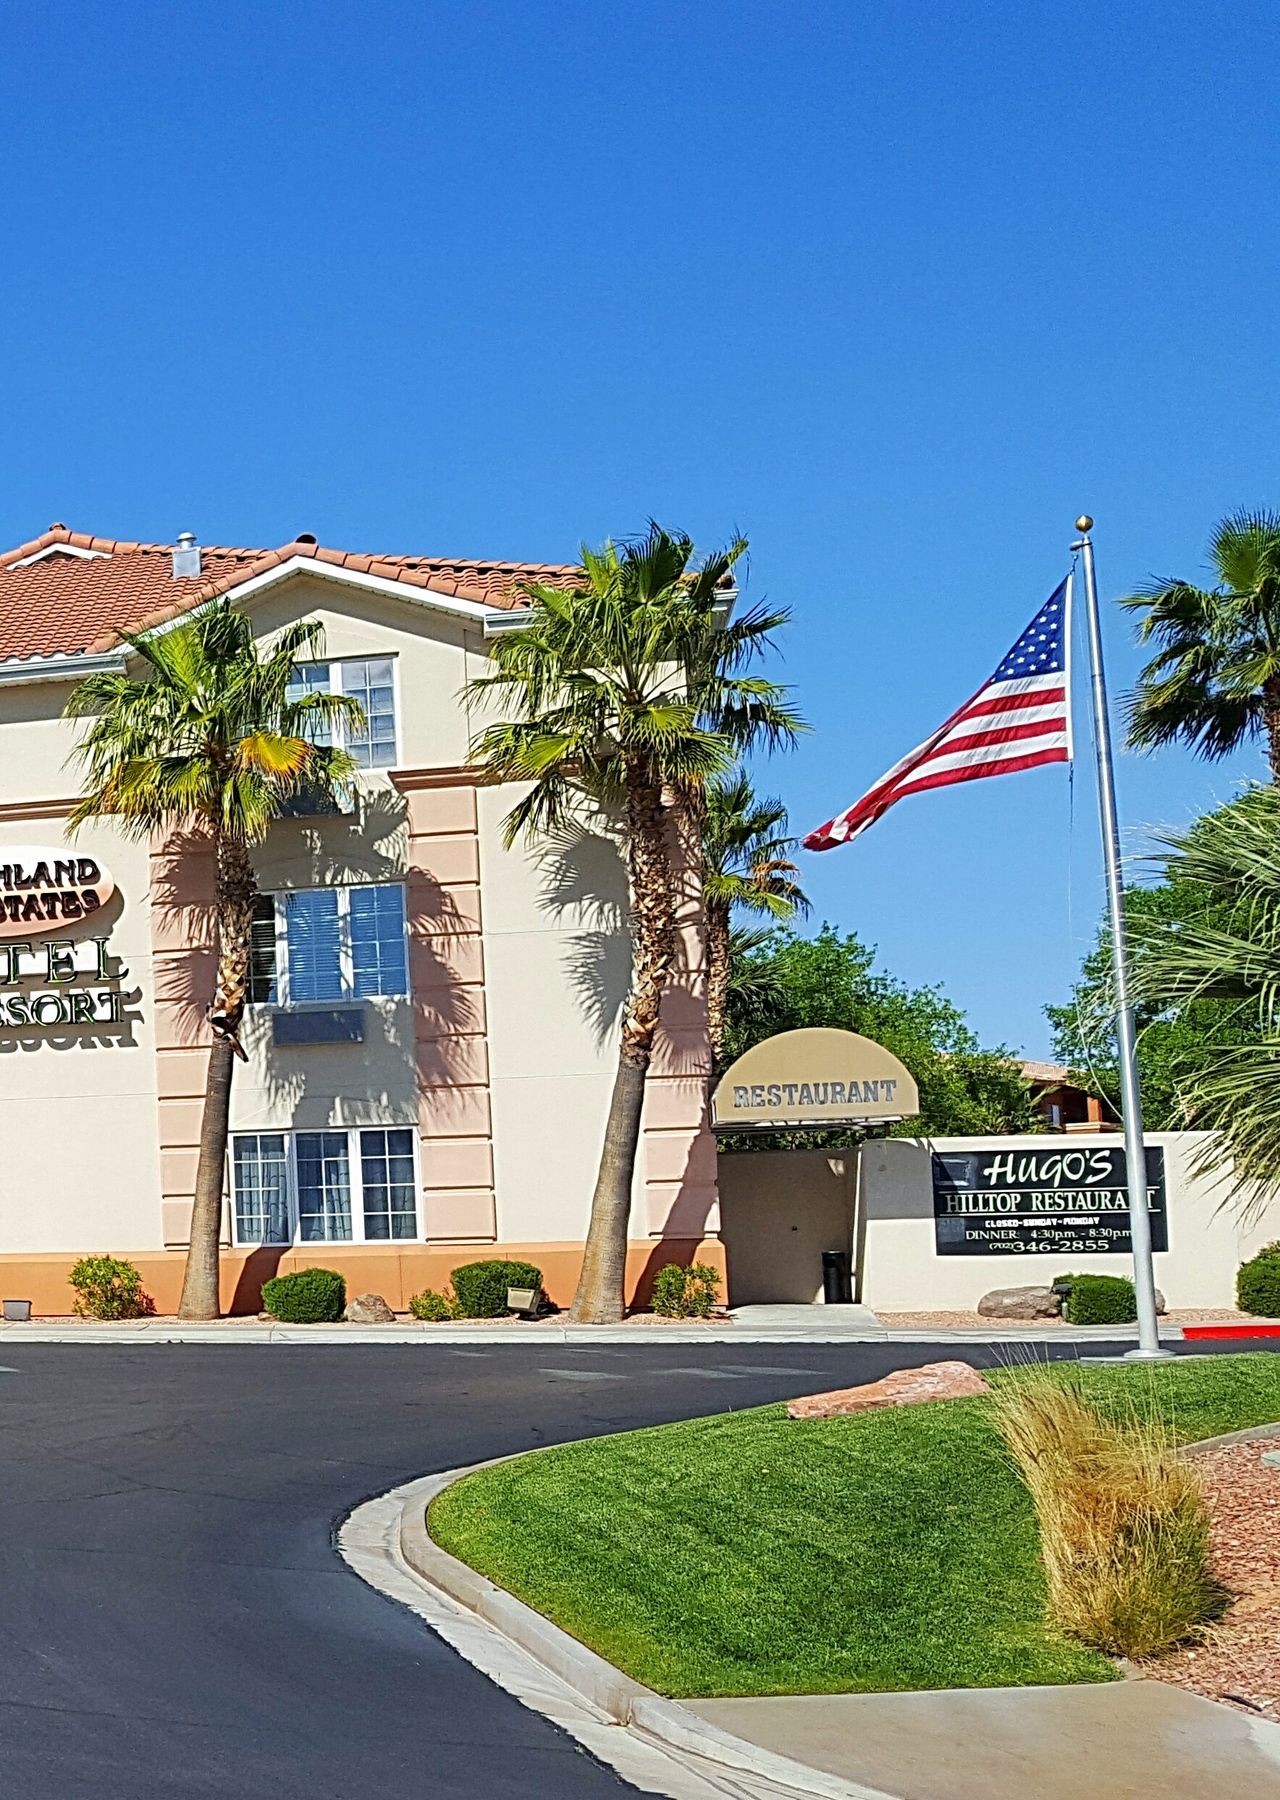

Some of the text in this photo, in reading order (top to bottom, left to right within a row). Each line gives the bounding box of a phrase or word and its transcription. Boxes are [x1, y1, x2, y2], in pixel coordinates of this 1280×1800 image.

[733, 1079, 897, 1108] RESTAURANT
[945, 1190, 1156, 1213] HILLTOP RESTAURAT
[1030, 1229, 1079, 1241] 4:30p.m.
